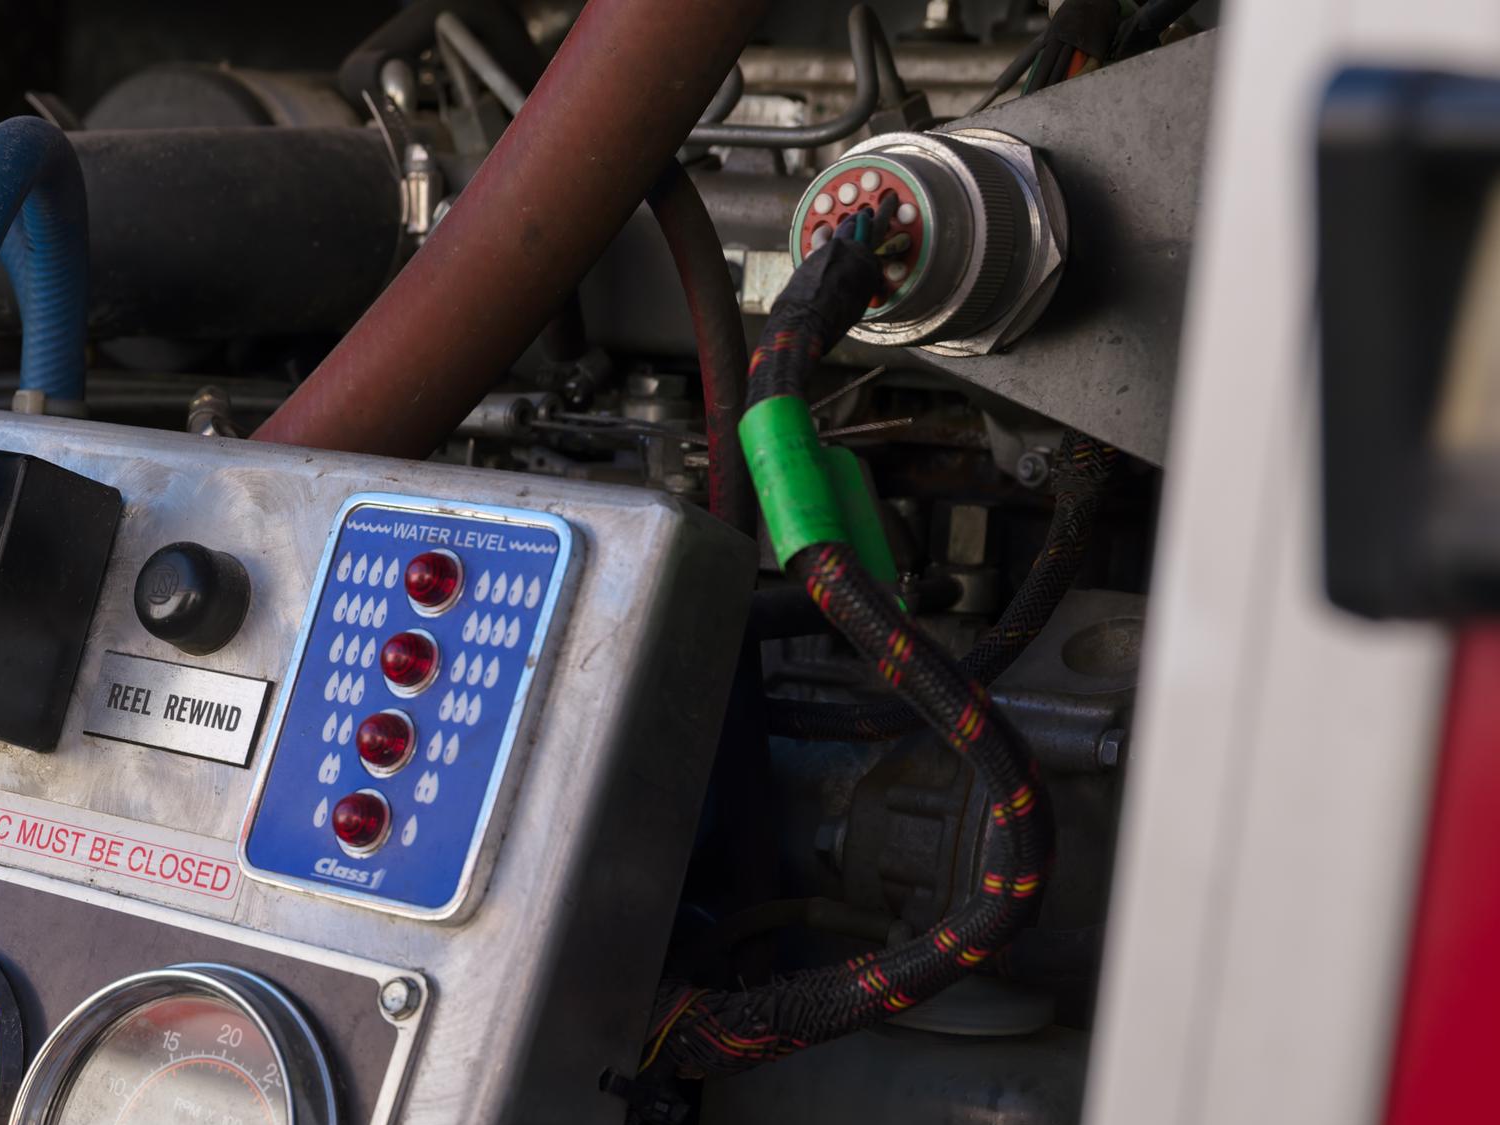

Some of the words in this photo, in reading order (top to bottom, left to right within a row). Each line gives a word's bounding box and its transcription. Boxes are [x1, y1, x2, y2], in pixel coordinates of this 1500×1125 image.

[393, 521, 451, 546] WATER
[454, 529, 507, 553] LEVEL
[106, 682, 152, 717] REEL
[163, 694, 242, 733] REWIND
[16, 819, 85, 857] MUST
[88, 835, 123, 867] BE
[128, 846, 231, 893] CLOSED
[162, 1030, 182, 1051] 15
[217, 1024, 243, 1048] 20
[108, 1077, 126, 1097] 10
